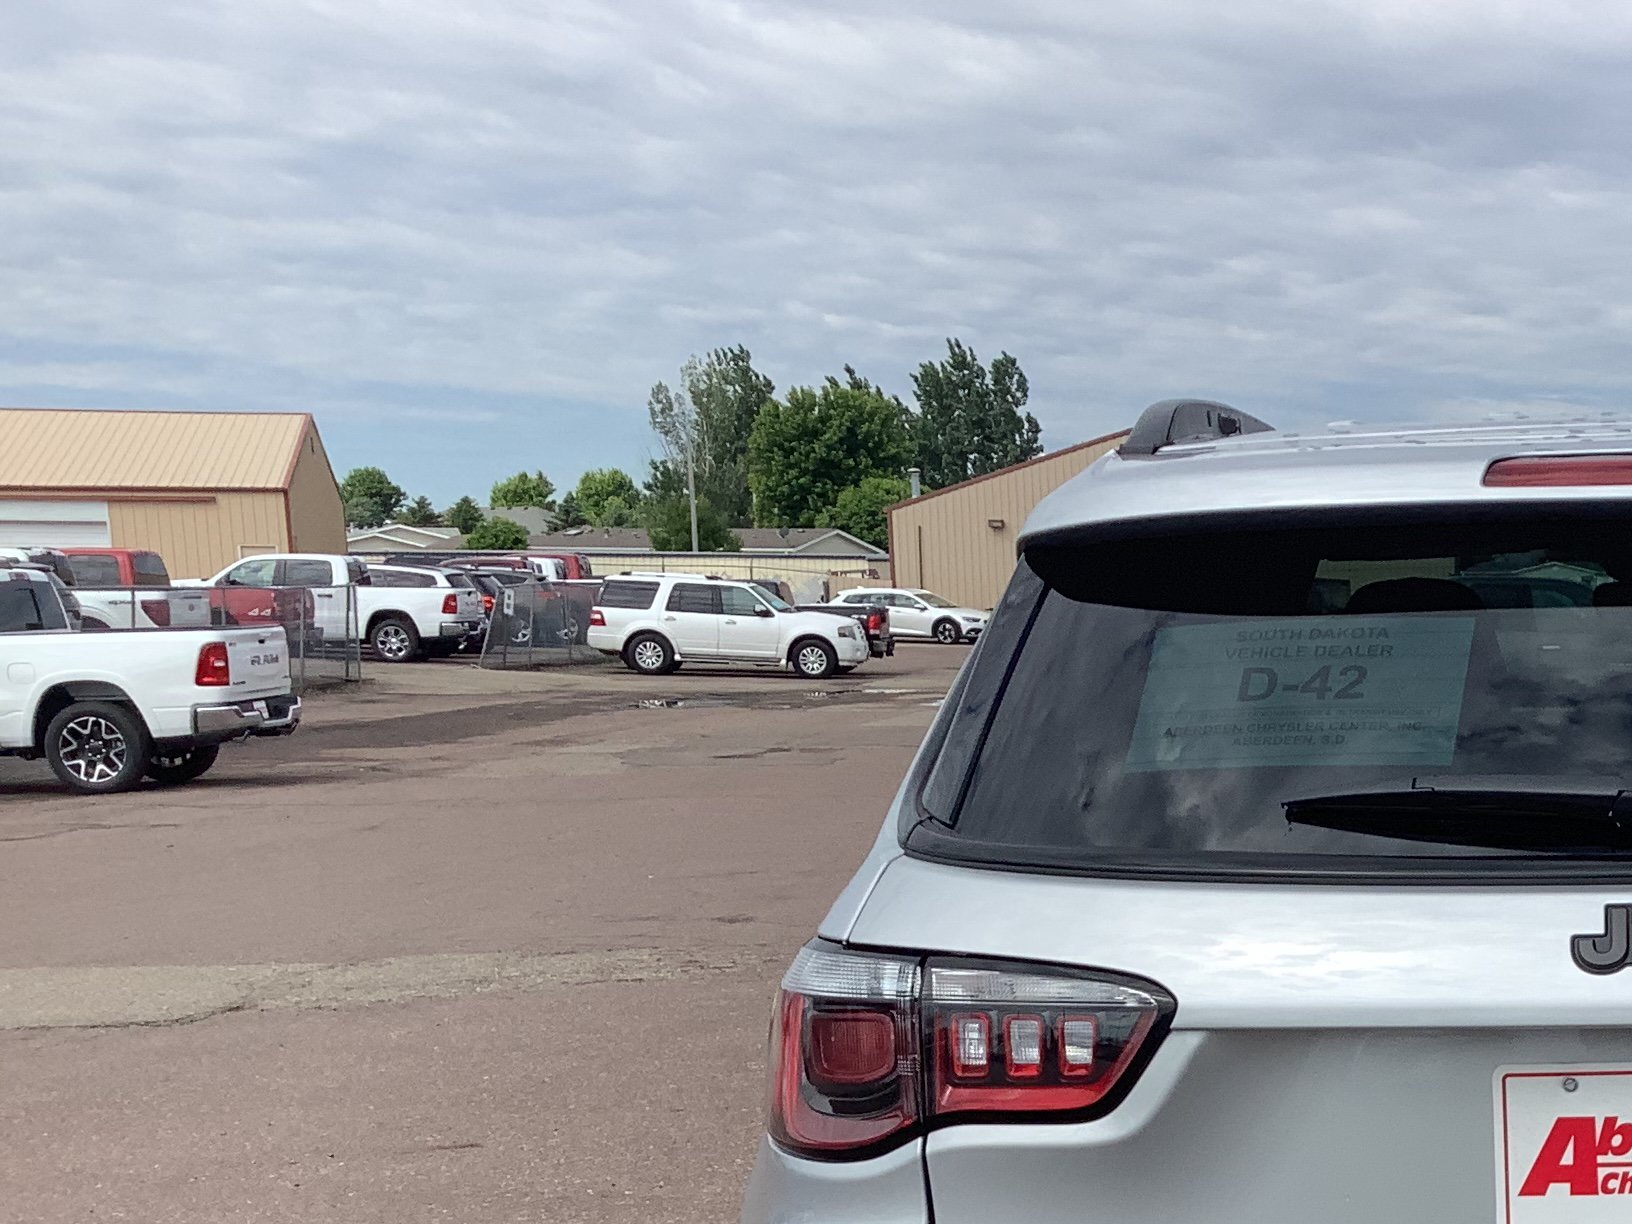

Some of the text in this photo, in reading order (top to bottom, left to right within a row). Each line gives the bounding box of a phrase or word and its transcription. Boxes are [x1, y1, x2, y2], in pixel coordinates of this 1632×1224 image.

[1235, 626, 1390, 643] SOUTH DAKOTA
[1225, 643, 1394, 660] VEHICLE DEALER
[1236, 664, 1368, 702] D-42
